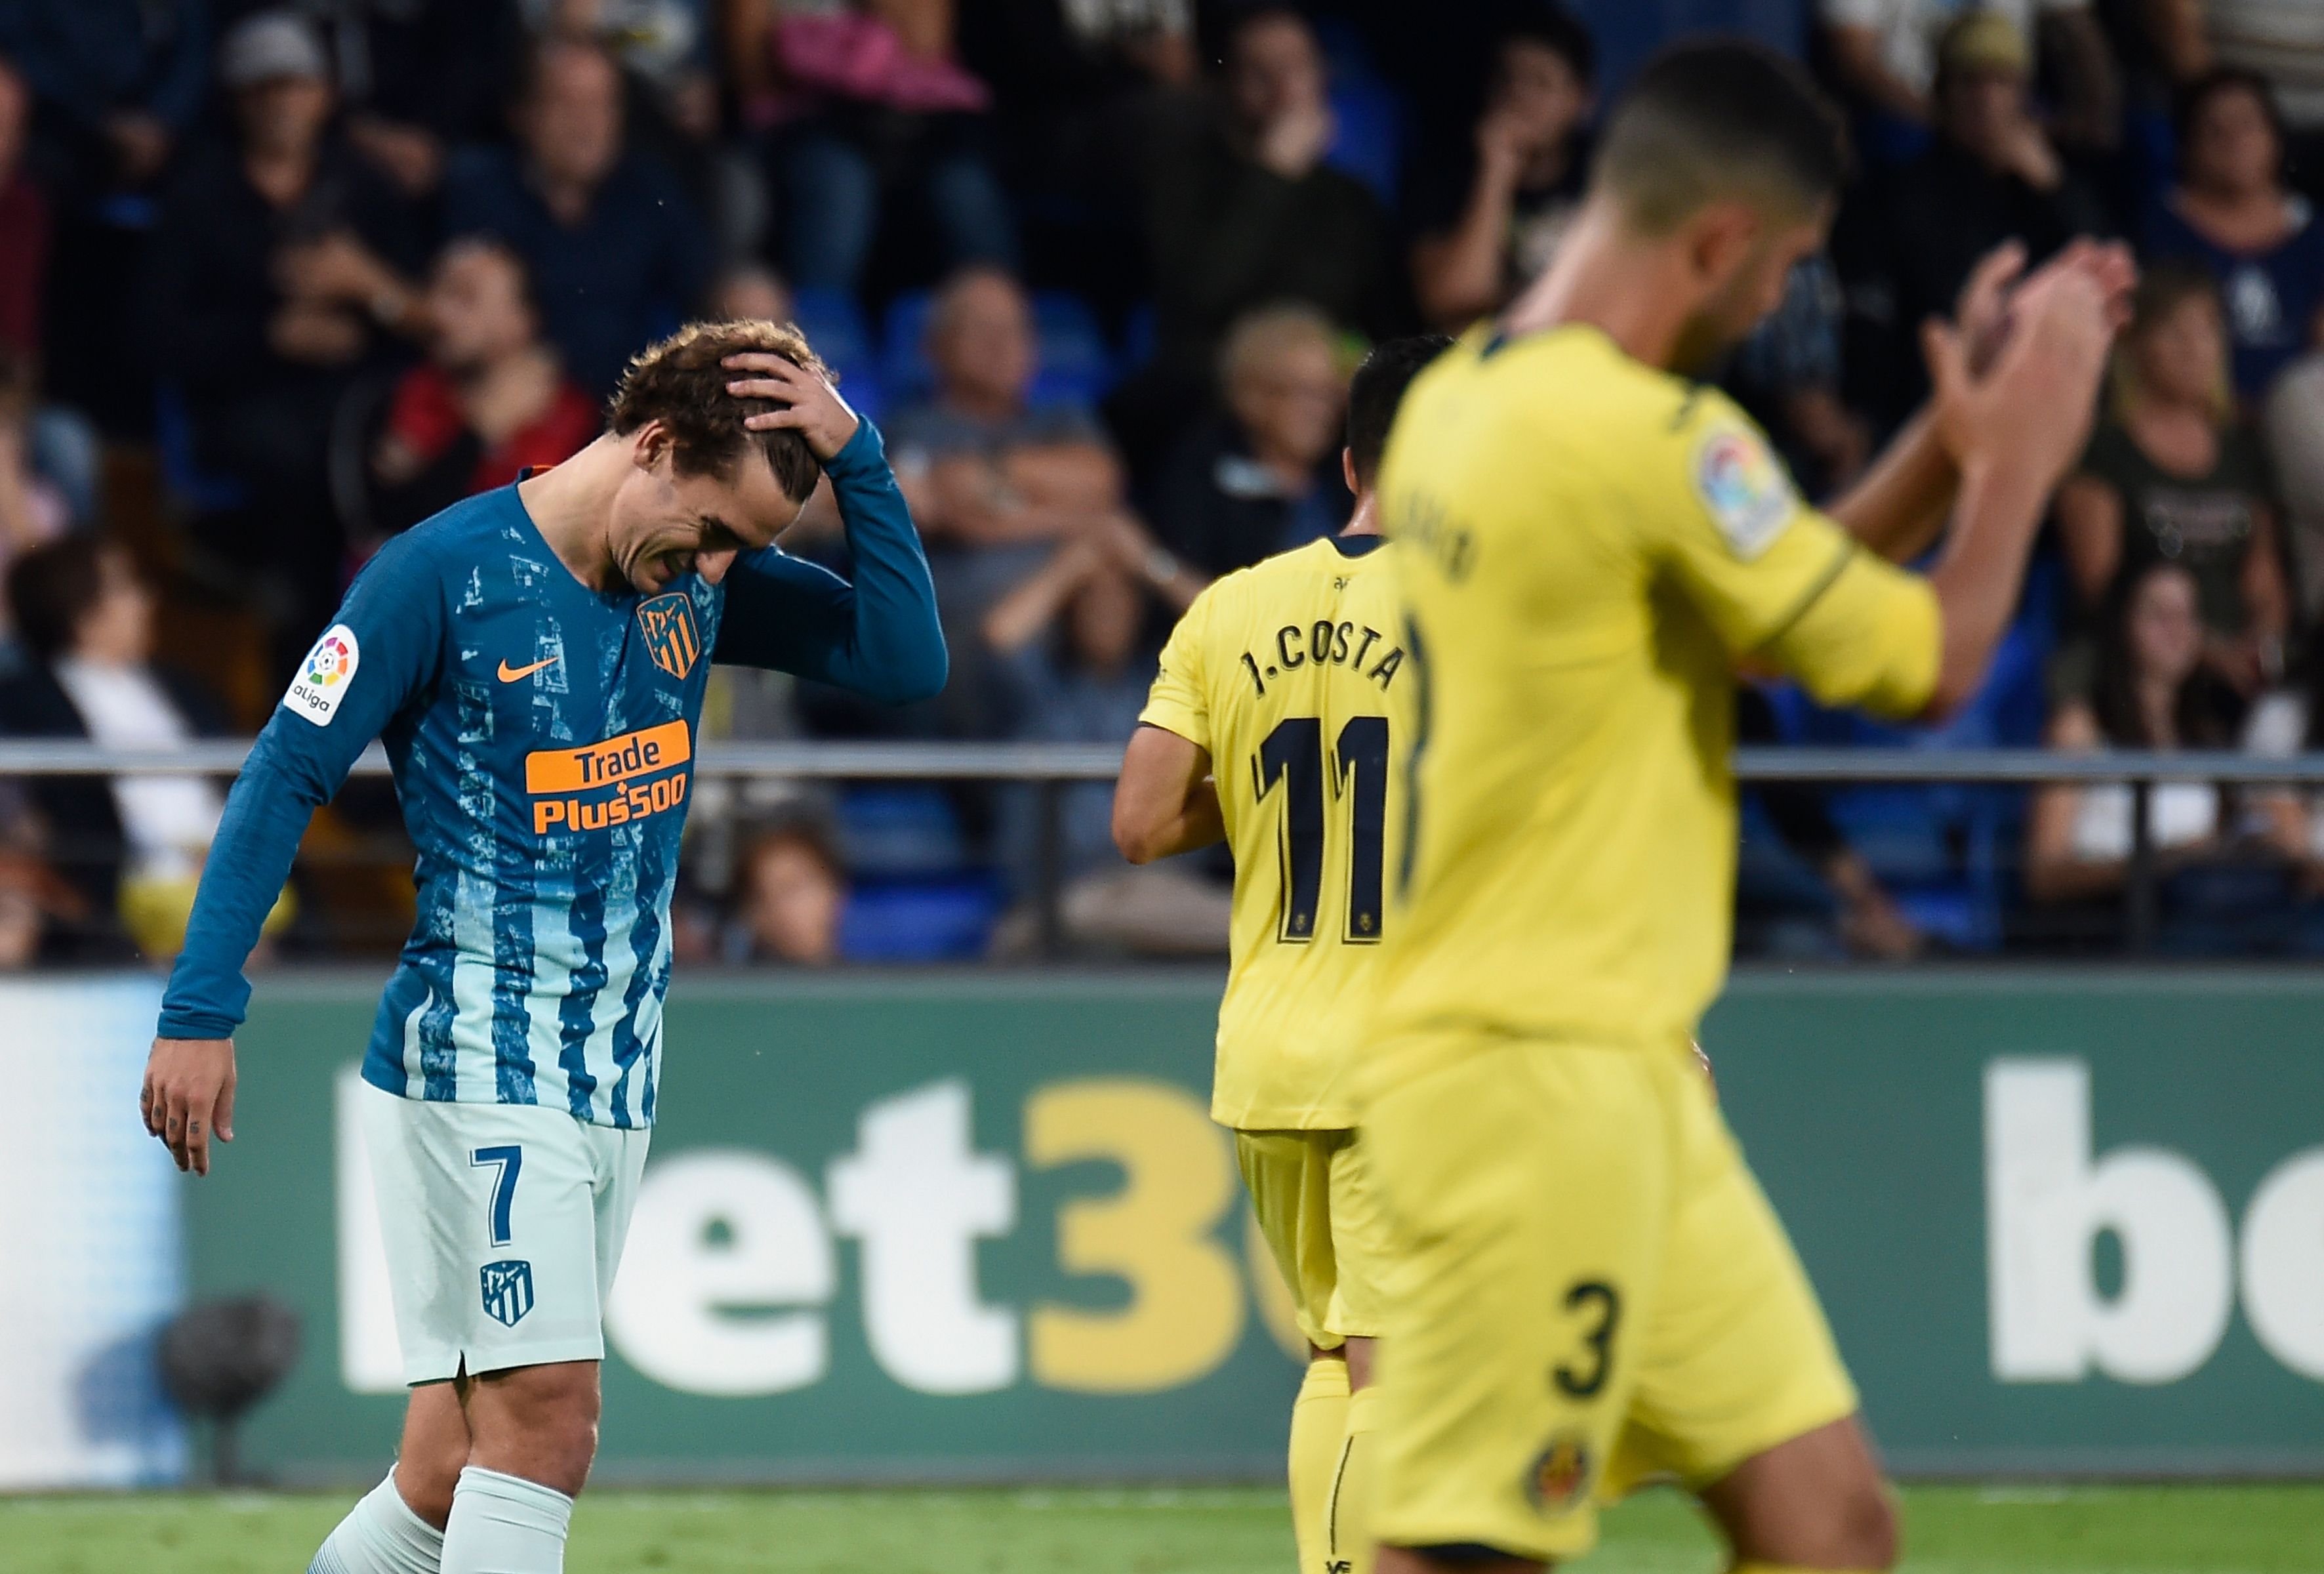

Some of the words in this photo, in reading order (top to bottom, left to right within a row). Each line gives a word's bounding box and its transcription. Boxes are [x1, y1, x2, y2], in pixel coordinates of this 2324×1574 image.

[292, 684, 331, 713] aLiga
[1240, 619, 1406, 700] J.COSTA
[533, 773, 687, 835] Plus500
[574, 736, 660, 783] Trade
[1251, 716, 1389, 945] 11
[338, 1066, 1309, 1396] et3
[470, 1145, 523, 1248] 7
[1551, 1278, 1623, 1404] 3
